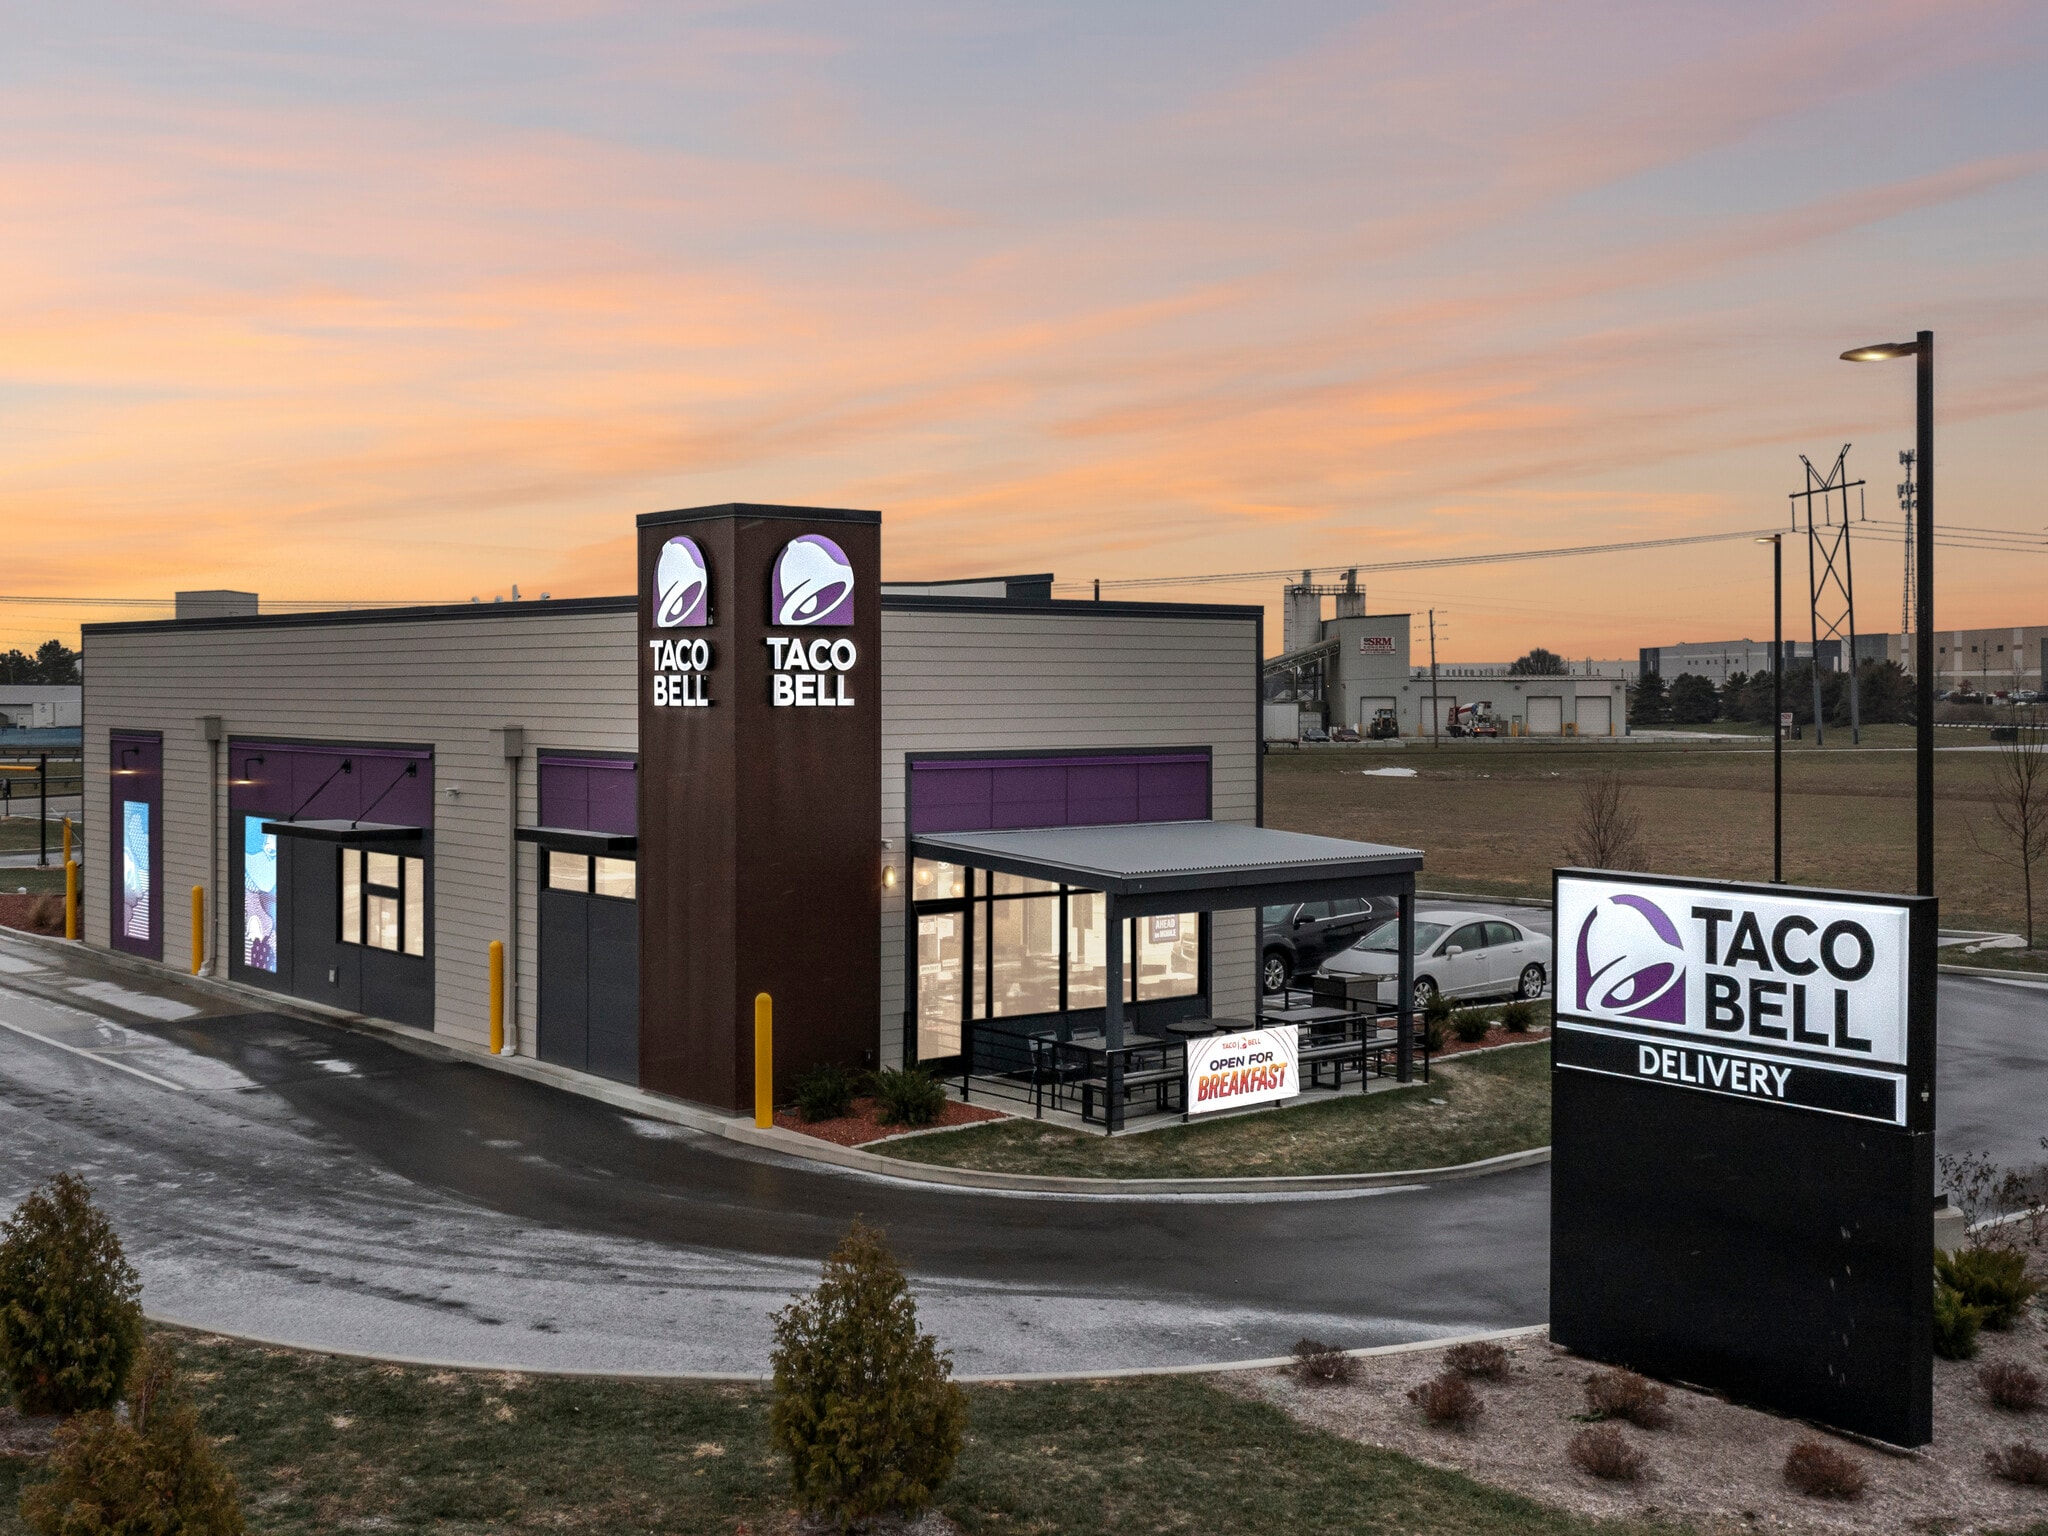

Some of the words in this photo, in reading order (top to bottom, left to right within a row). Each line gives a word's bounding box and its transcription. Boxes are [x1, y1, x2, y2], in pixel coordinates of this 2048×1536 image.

[650, 638, 709, 672] TACO
[766, 637, 857, 671] TACO
[1369, 637, 1392, 645] SRM
[653, 674, 709, 707] BELL
[773, 674, 855, 707] BELL
[1155, 918, 1176, 930] AHEAD
[1691, 905, 1875, 982] TACO
[1705, 972, 1872, 1053] BELL
[1222, 1041, 1237, 1050] TACO
[1248, 1038, 1261, 1046] BELL
[1210, 1056, 1245, 1070] OPEN
[1249, 1052, 1273, 1065] FOR
[1639, 1044, 1792, 1098] DELIVERY
[1198, 1063, 1287, 1101] BREAKFAST
